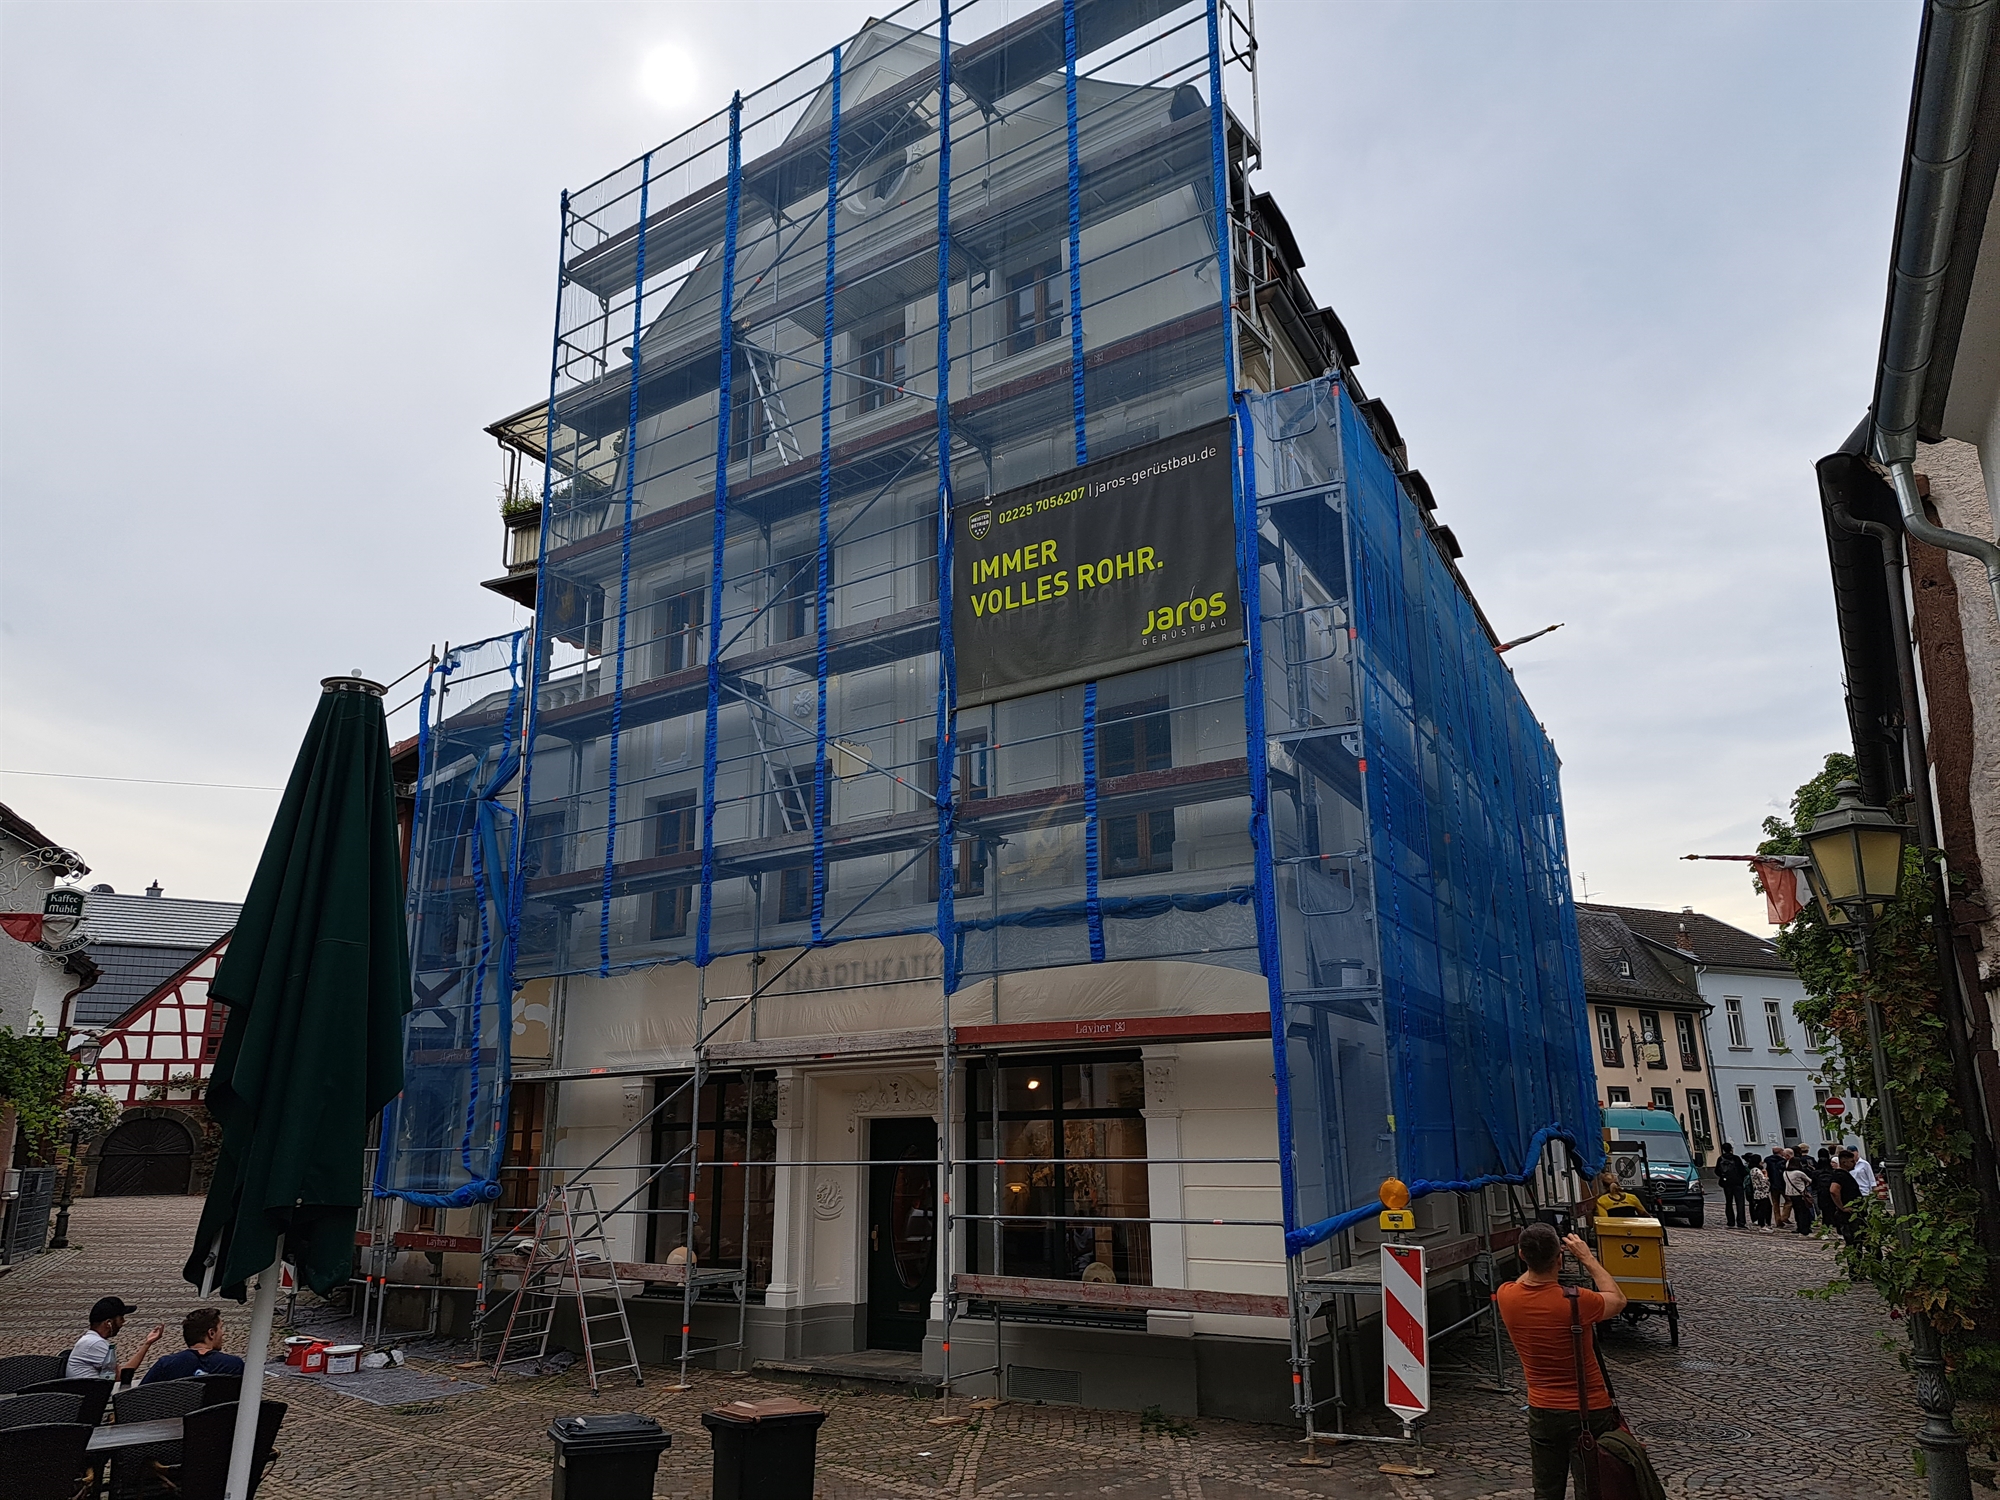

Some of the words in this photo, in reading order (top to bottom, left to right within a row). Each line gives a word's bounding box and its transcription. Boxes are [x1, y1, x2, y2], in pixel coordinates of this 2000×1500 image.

[998, 503, 1033, 524] 02225
[1035, 486, 1085, 513] 7056207
[1095, 446, 1217, 498] jaros-gerüstbau.de
[972, 539, 1058, 585] IMMER
[970, 570, 1069, 617] VOLLES
[1077, 546, 1164, 590] ROHR.
[1142, 618, 1227, 646] GERÜSTBAU
[48, 904, 78, 914] Mühle
[50, 893, 81, 903] Kaffee-
[1075, 1022, 1111, 1034] Layher
